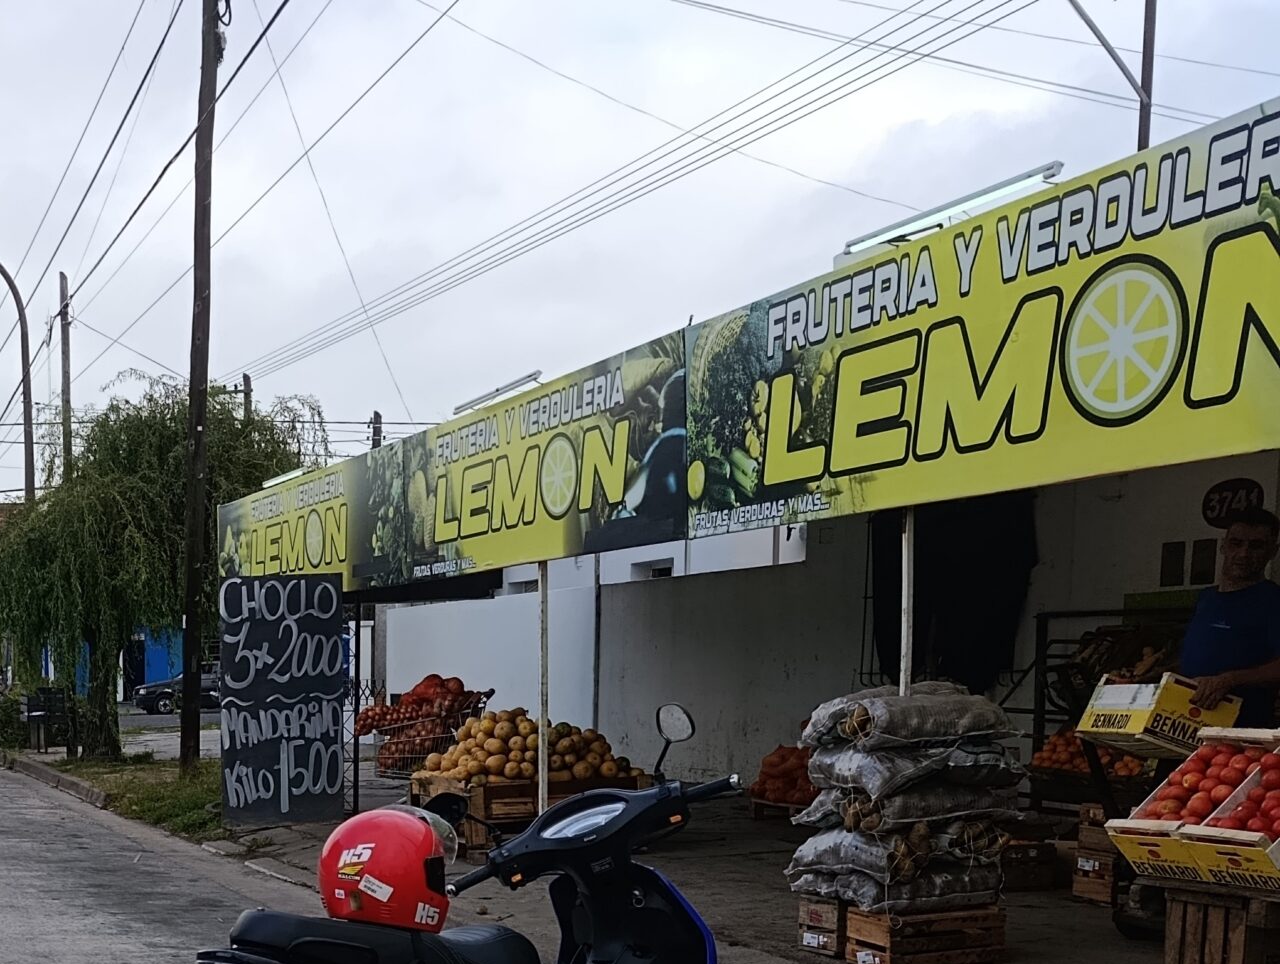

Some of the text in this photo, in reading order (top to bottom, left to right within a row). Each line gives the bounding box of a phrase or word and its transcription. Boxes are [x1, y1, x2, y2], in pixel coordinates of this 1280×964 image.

[767, 246, 938, 359] FRUTERIA
[953, 225, 983, 297] Y
[435, 368, 625, 468] FRUTERIA Y VERDULERIA
[251, 471, 345, 522] FRUTERIA Y VERDULERIA
[433, 417, 631, 545] LEMON
[732, 499, 785, 525] VERDURAS
[788, 498, 796, 515] Y
[250, 503, 348, 576] LEMON
[219, 578, 338, 624] CHOCLO
[1091, 713, 1131, 729] BENNARDI
[338, 843, 376, 867] H5
[1132, 860, 1202, 881] BENNARDI
[414, 902, 440, 925] H5
